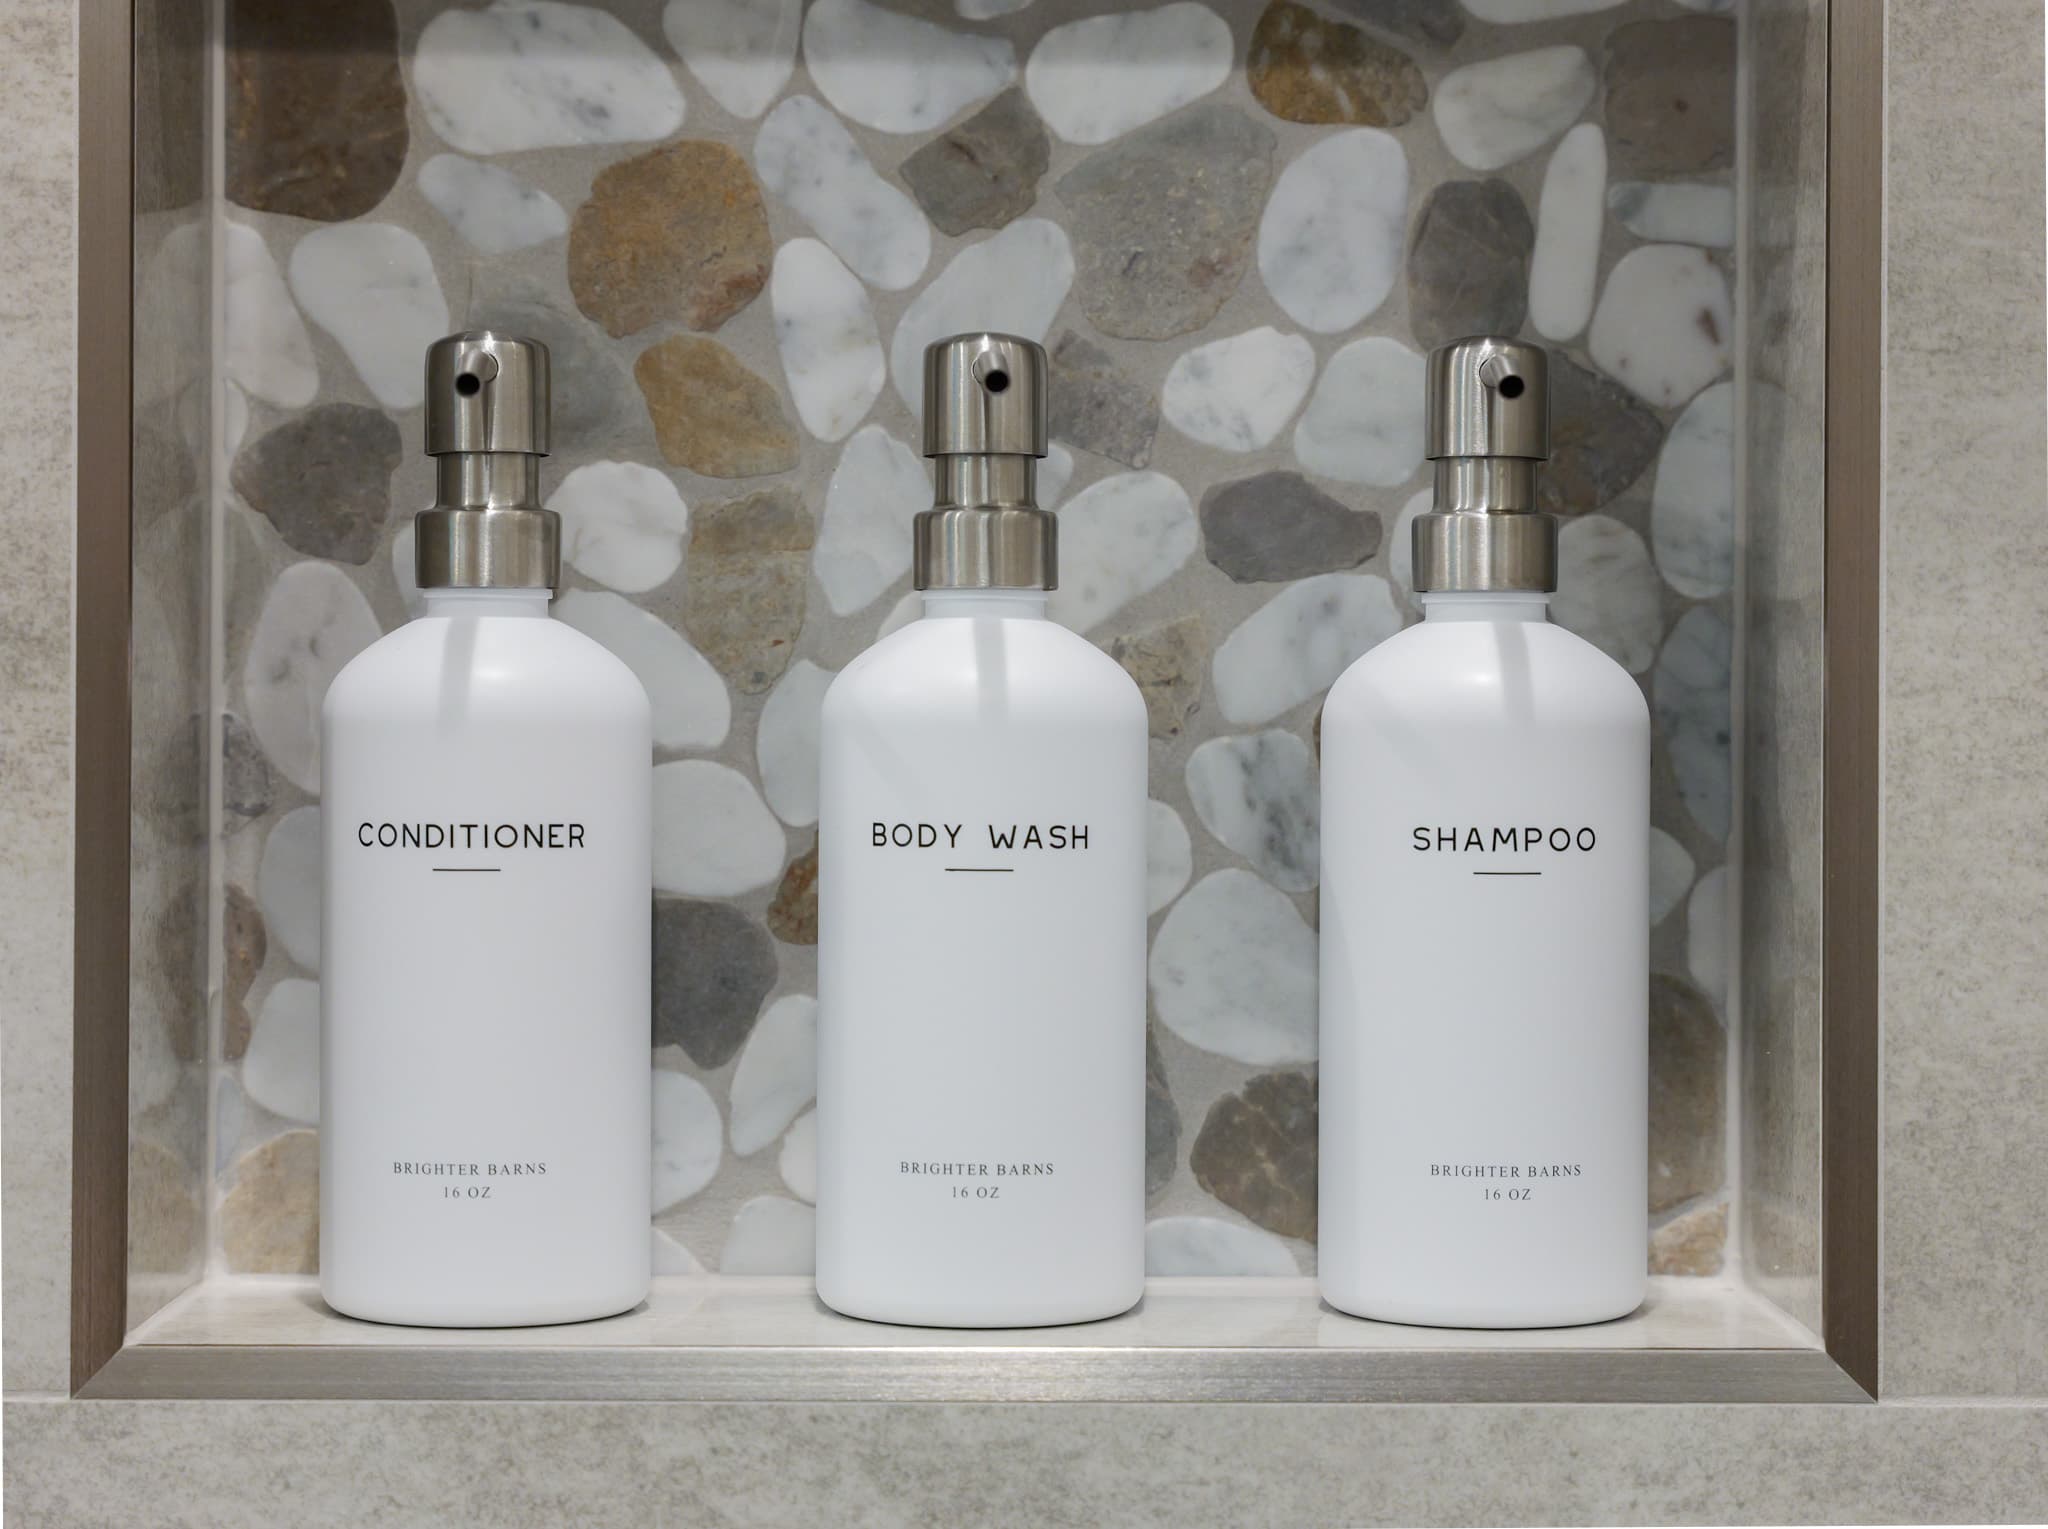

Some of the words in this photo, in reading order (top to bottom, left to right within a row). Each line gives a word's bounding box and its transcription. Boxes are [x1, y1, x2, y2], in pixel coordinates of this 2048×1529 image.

[358, 822, 585, 849] CONDITIONER
[872, 822, 963, 849] BODY
[988, 823, 1089, 850] WASH
[1412, 826, 1597, 853] SHAMPOO
[393, 1161, 480, 1176] BRIGHTER
[487, 1162, 547, 1176] BARNS
[900, 1161, 988, 1176] BRIGHTER
[996, 1162, 1055, 1177] BARNS
[1430, 1164, 1521, 1178] BRIGHTER
[1527, 1164, 1582, 1178] BARNS
[443, 1186, 461, 1199] 16
[467, 1186, 491, 1199] OZ
[952, 1186, 969, 1199] 16
[976, 1186, 1000, 1199] OZ
[1484, 1188, 1501, 1201] 16
[1508, 1188, 1531, 1201] OZ
